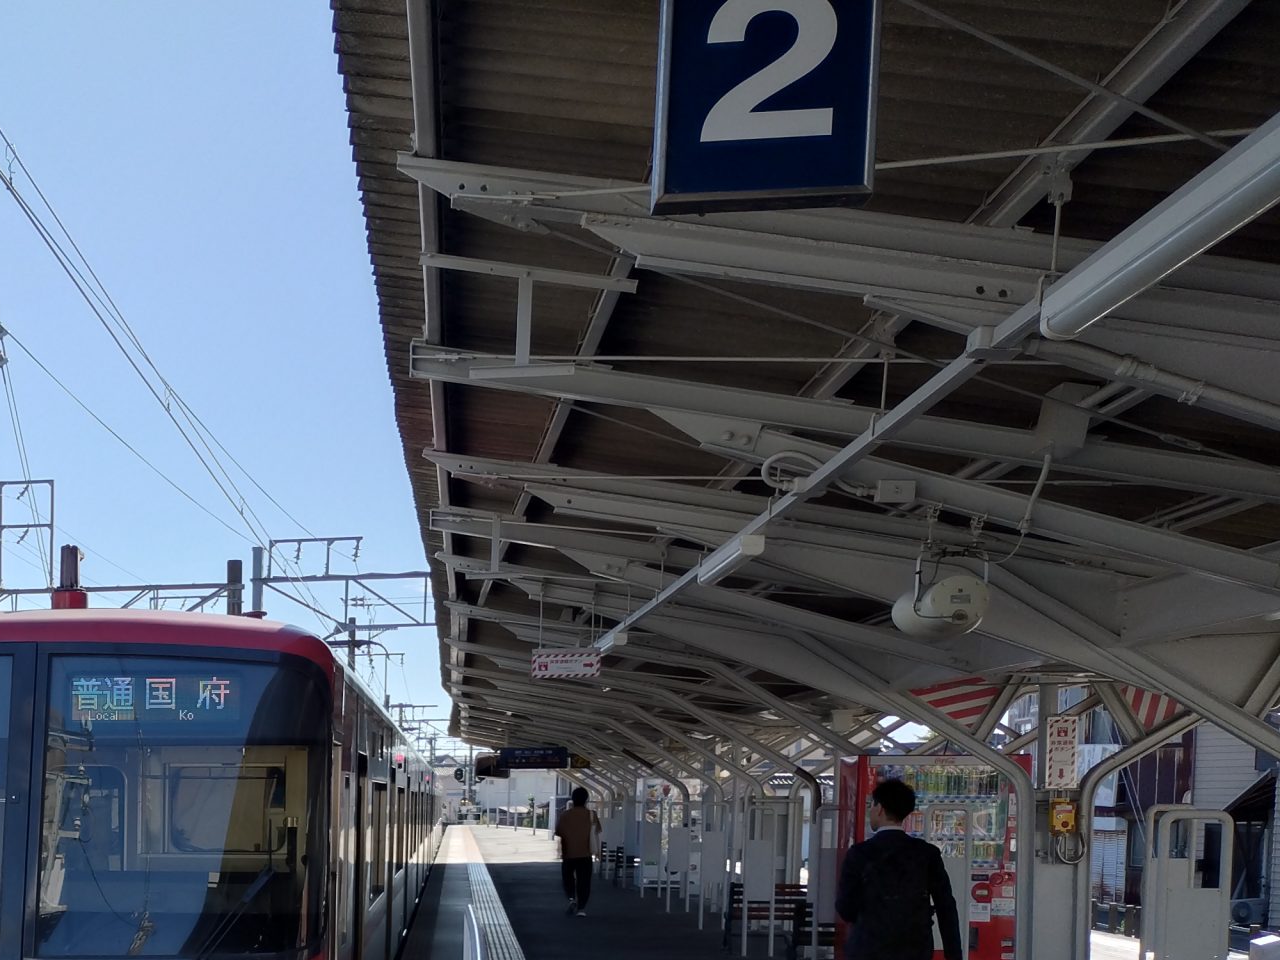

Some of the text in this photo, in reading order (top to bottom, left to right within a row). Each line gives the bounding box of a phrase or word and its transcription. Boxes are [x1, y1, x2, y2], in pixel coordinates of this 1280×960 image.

[700, 0, 838, 142] 2
[72, 677, 135, 711] 普通
[88, 710, 194, 721] Local Ko
